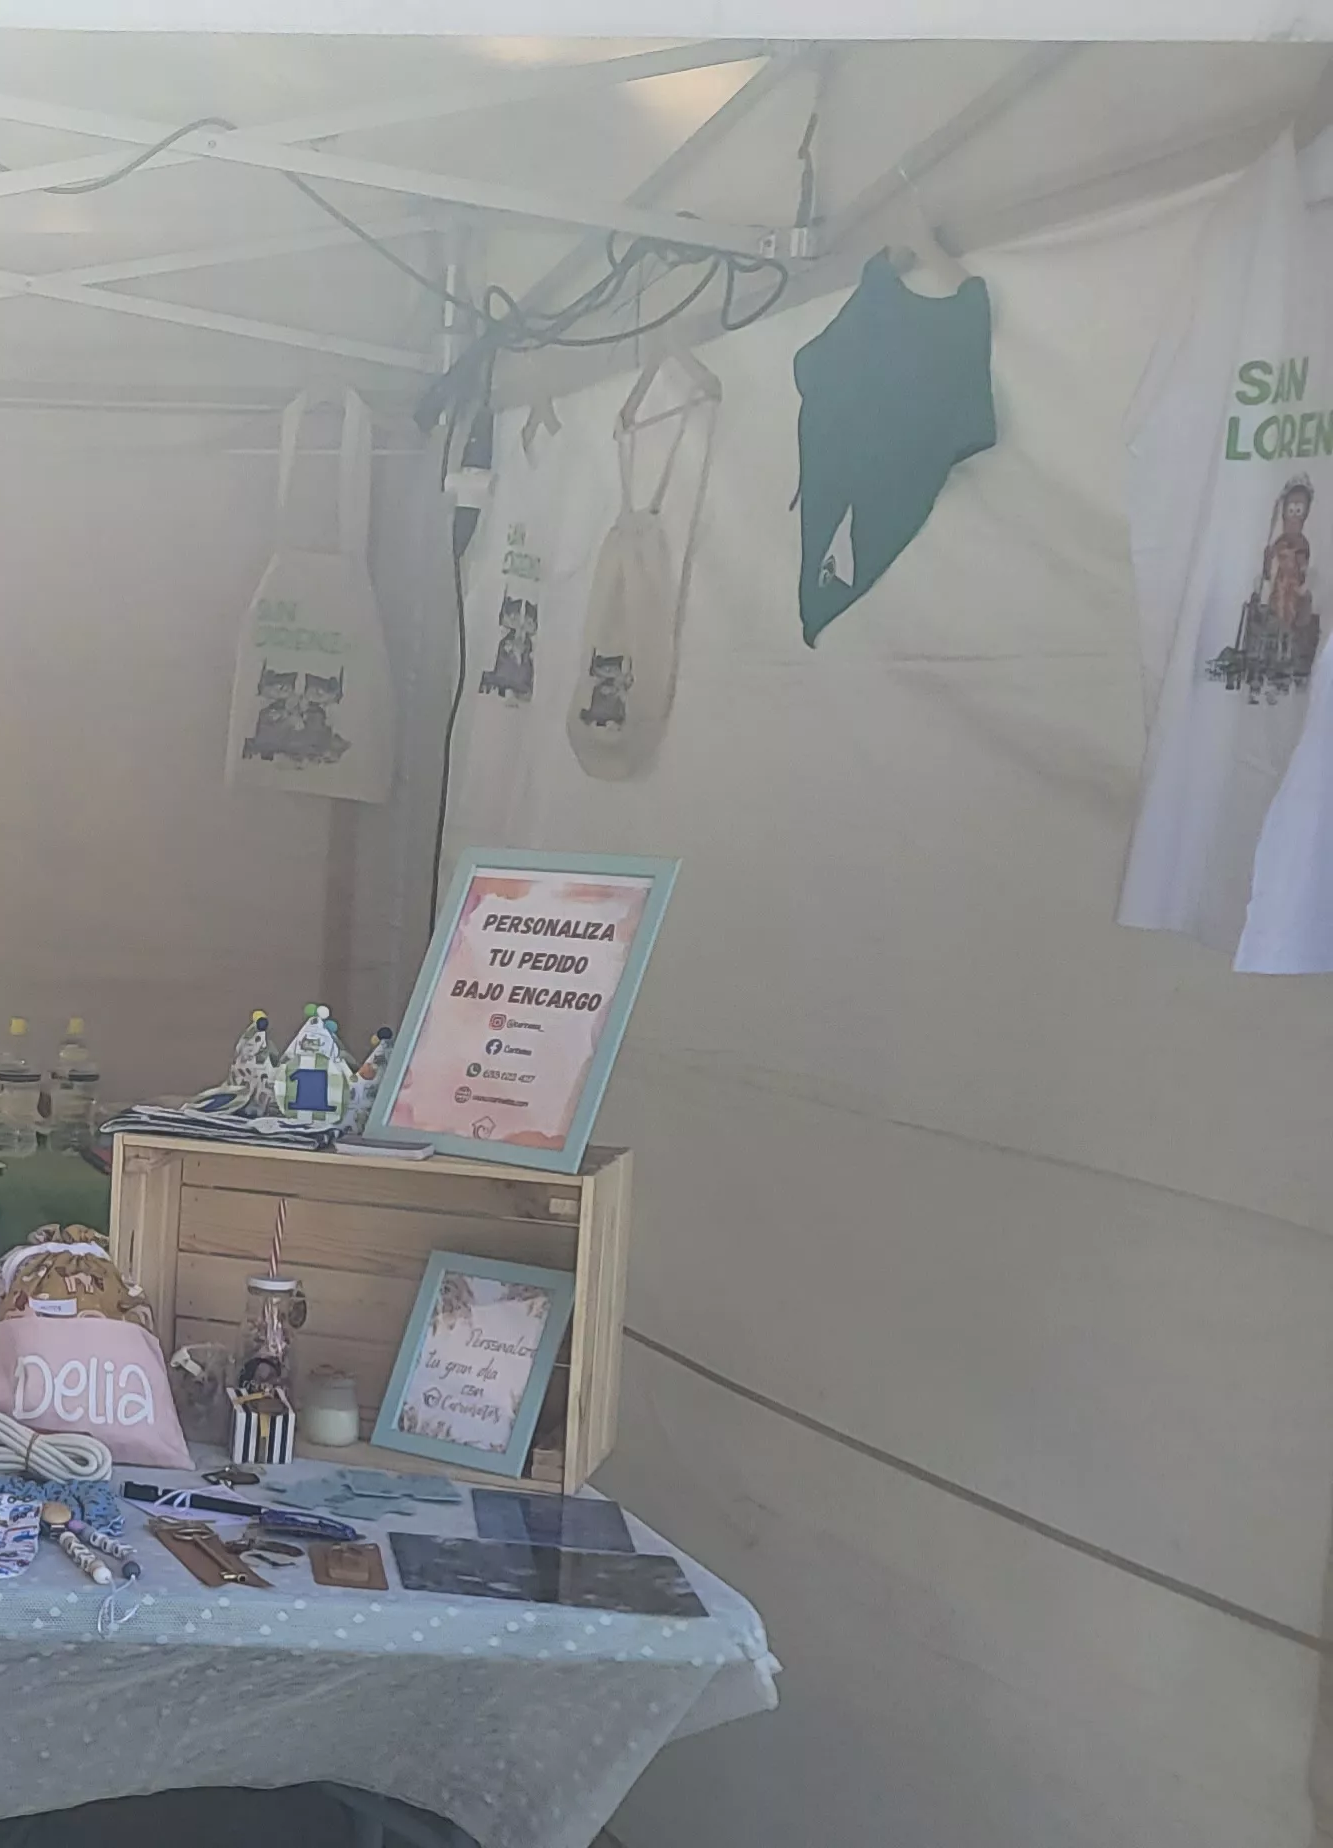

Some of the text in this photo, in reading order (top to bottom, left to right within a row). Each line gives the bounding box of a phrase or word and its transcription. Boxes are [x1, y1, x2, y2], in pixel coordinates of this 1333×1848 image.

[1235, 356, 1309, 406] SAN
[482, 913, 616, 941] PERSONALIZA
[489, 949, 589, 974] TU PEDIDO
[450, 979, 602, 1011] BAJO ENCARGO
[288, 1068, 337, 1112] 1
[13, 1355, 155, 1426] Delia
